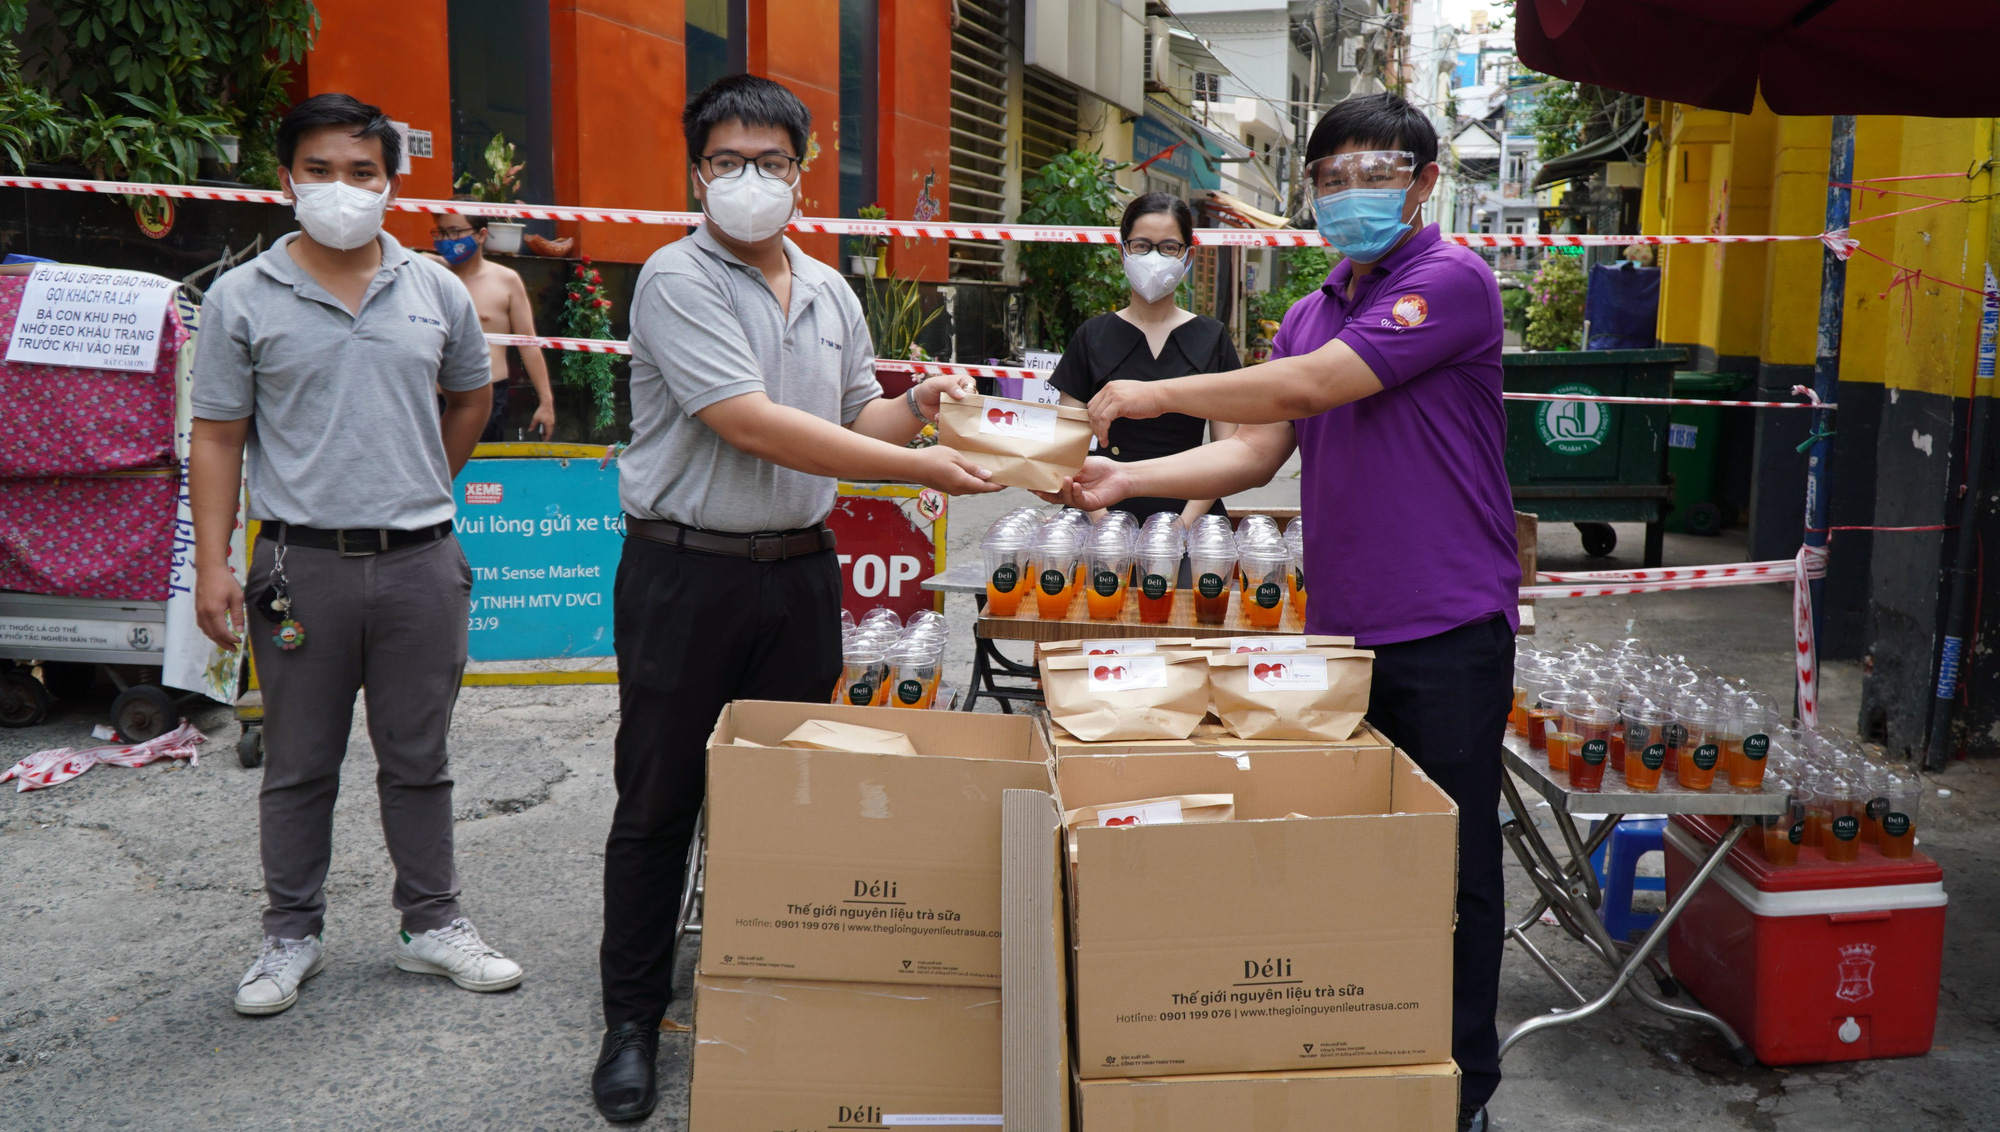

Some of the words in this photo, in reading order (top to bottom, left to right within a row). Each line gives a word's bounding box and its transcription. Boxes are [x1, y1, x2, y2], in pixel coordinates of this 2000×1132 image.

[32, 270, 51, 281] YÊU
[54, 271, 75, 283] CẦU
[77, 273, 111, 286] SUPER
[113, 275, 139, 287] GIAO
[140, 277, 171, 289] HÀNG
[47, 288, 64, 304] GỌI
[66, 287, 100, 303] KHÁCH
[104, 292, 118, 304] RA
[118, 291, 140, 305] LẤY
[36, 307, 52, 320] BÀ
[56, 310, 81, 322] CON
[84, 312, 110, 323] KHU
[112, 312, 137, 325] PHỐ
[20, 322, 48, 335] NHỚ
[49, 325, 75, 336] ĐEO
[77, 325, 112, 338] KHẨU
[114, 328, 155, 341] TRANG
[17, 337, 61, 350] TRƯỚC
[63, 341, 83, 352] KHI
[86, 341, 111, 354] VÀO
[466, 483, 503, 496] XEME
[452, 516, 484, 534] Vui
[489, 515, 535, 537] lòng
[540, 513, 571, 537] gửi
[575, 517, 598, 531] xe
[603, 514, 627, 534] tại
[501, 566, 546, 580] Sense
[548, 564, 600, 578] Market
[481, 596, 525, 610] TNHH
[528, 594, 562, 608] MTV
[565, 592, 601, 607] DVCI
[9, 624, 34, 632] THUỐC
[48, 625, 60, 633] CÓ
[62, 625, 78, 634] THỂ
[853, 880, 898, 898] Déli
[787, 903, 812, 916] Thế
[813, 904, 837, 918] giới
[840, 907, 888, 921] nguyên
[890, 908, 913, 922] liệu
[916, 909, 934, 921] trà
[936, 908, 961, 922] sữa
[735, 918, 772, 928] Hotline:
[775, 919, 800, 930] 0901
[802, 921, 820, 930] 199
[821, 922, 840, 932] 076
[1243, 957, 1293, 979] Déli
[1172, 990, 1199, 1006] Thế
[1200, 989, 1226, 1006] giới
[1230, 987, 1283, 1004] nguyên
[1286, 986, 1312, 1000] liệu
[1314, 985, 1335, 998] trà
[1338, 983, 1365, 997] sữa
[1116, 1012, 1157, 1024] Hotline:
[1159, 1011, 1186, 1022] 0901
[1189, 1010, 1209, 1021] 199
[1211, 1009, 1232, 1019] 076
[1240, 1001, 1419, 1018] www.thegioinguyenlieutrasua.com
[838, 1105, 881, 1123] Déli
